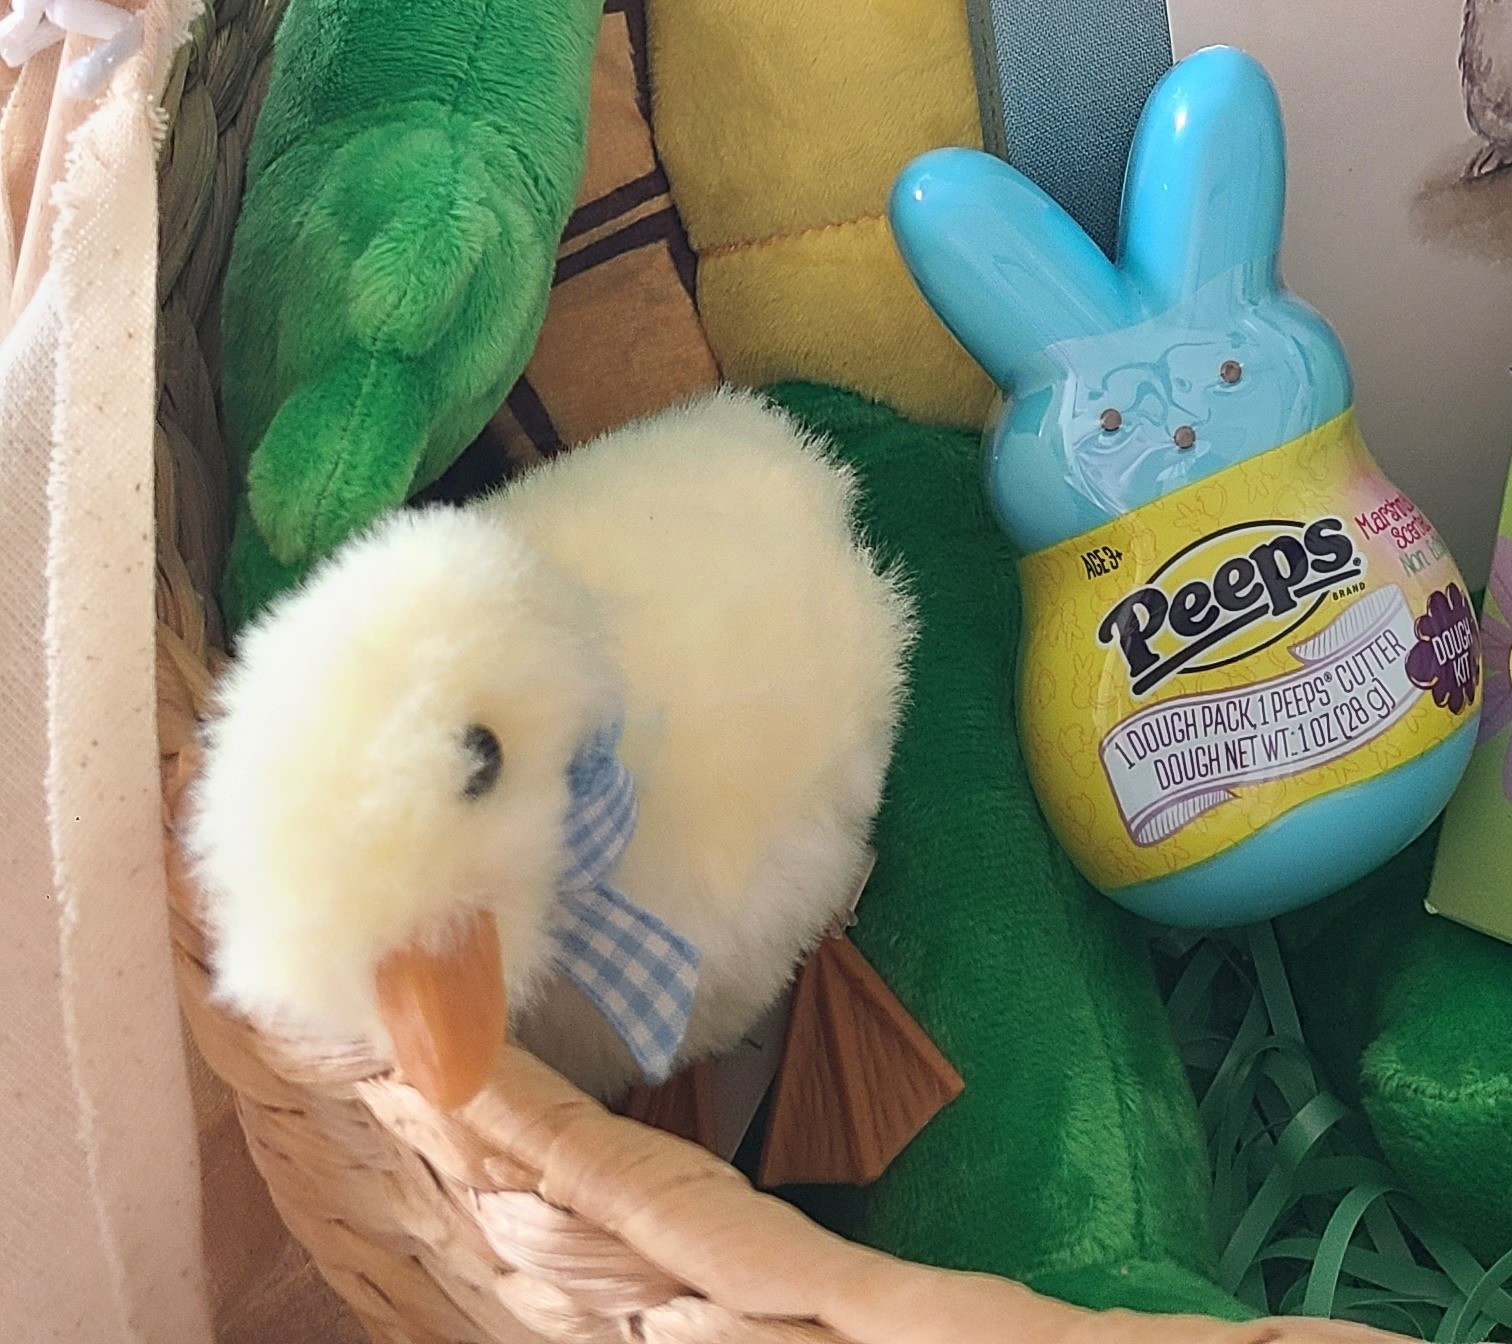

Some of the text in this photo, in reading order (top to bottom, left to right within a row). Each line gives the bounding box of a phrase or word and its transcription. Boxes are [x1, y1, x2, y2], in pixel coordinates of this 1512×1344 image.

[1080, 546, 1123, 580] AGE 3+
[1332, 581, 1367, 602] BRAND
[1431, 619, 1473, 666] DOUGH
[1452, 651, 1472, 687] KIT
[1114, 741, 1136, 769] 1
[1127, 708, 1198, 761] DOUGH
[1202, 697, 1258, 738] PACK,
[1257, 694, 1270, 727] 1
[1335, 628, 1407, 694] CUTTER
[1153, 741, 1222, 791] DOUGH
[1224, 734, 1258, 772] NET
[1298, 723, 1311, 754] 1
[1309, 712, 1339, 748] OZ
